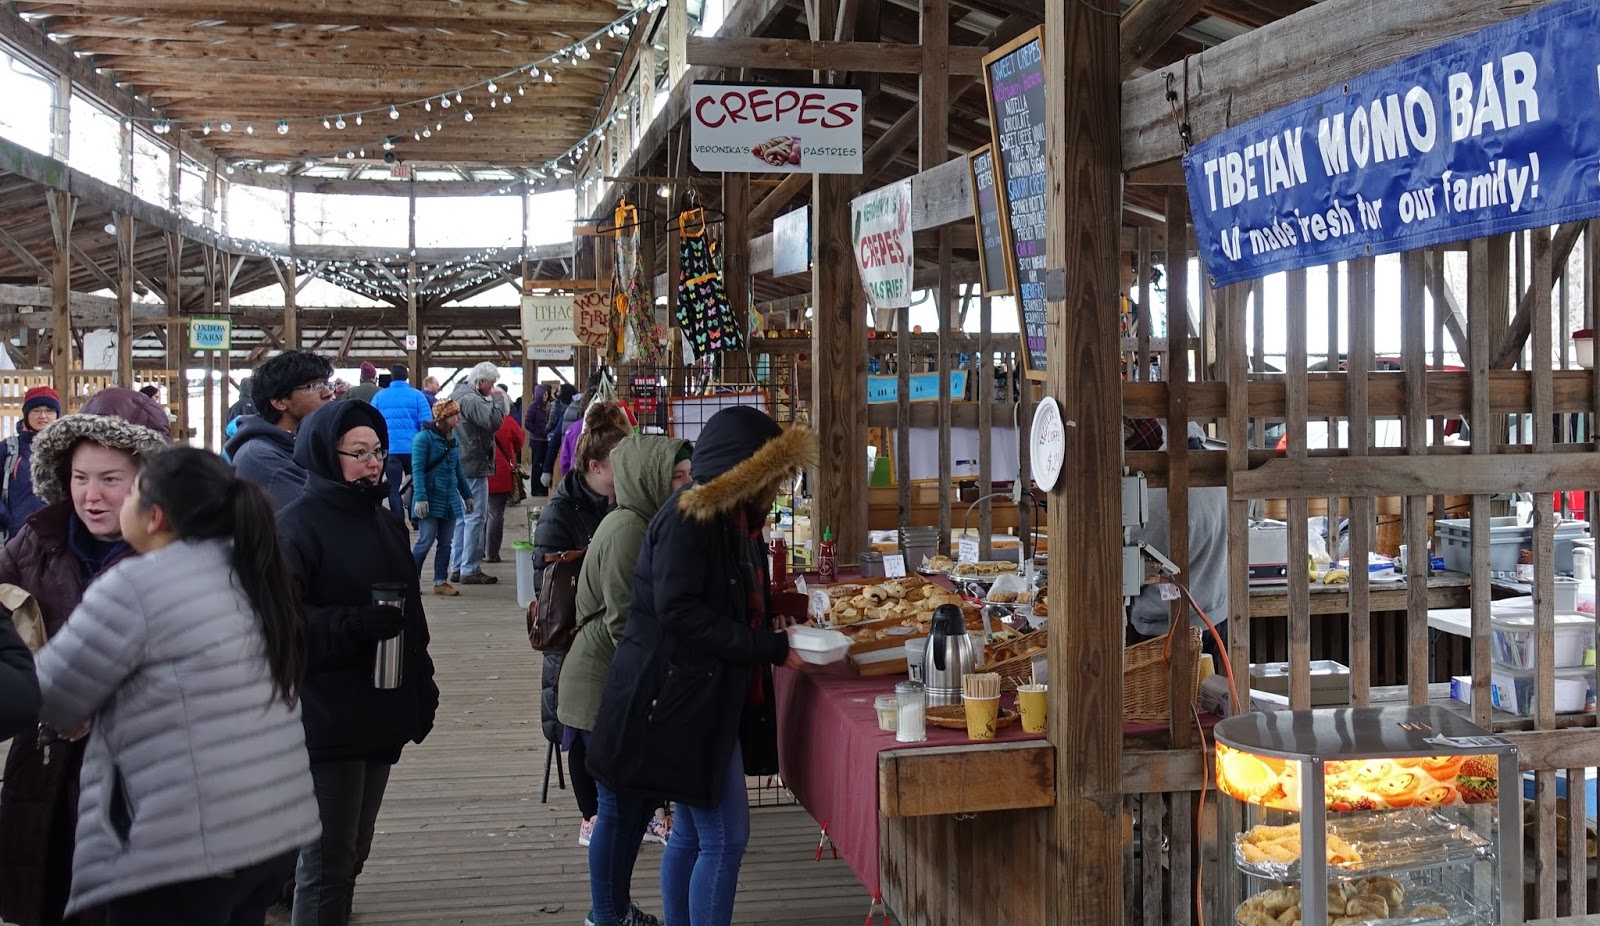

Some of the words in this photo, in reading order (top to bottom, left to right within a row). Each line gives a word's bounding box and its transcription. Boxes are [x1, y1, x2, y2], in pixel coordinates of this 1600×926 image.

[993, 53, 1016, 81] SWEET
[1016, 38, 1042, 71] CREPES
[695, 89, 859, 129] CREPES
[1004, 94, 1029, 116] NUTELLA
[1000, 131, 1018, 152] SWEET
[1203, 126, 1307, 213] TIBETAN
[1317, 85, 1437, 177] MOMO
[1447, 50, 1541, 143] BAR
[694, 146, 750, 154] VERONIKA'S
[803, 147, 857, 157] PASTRIES
[977, 170, 993, 191] CREPES
[1249, 211, 1298, 255] made
[1298, 204, 1355, 242] fresh
[1356, 193, 1382, 231] for
[1398, 183, 1436, 225] our
[1441, 151, 1541, 213] family!
[860, 228, 905, 270] CREPES
[193, 323, 228, 332] OXBOW
[196, 331, 224, 341] FARM
